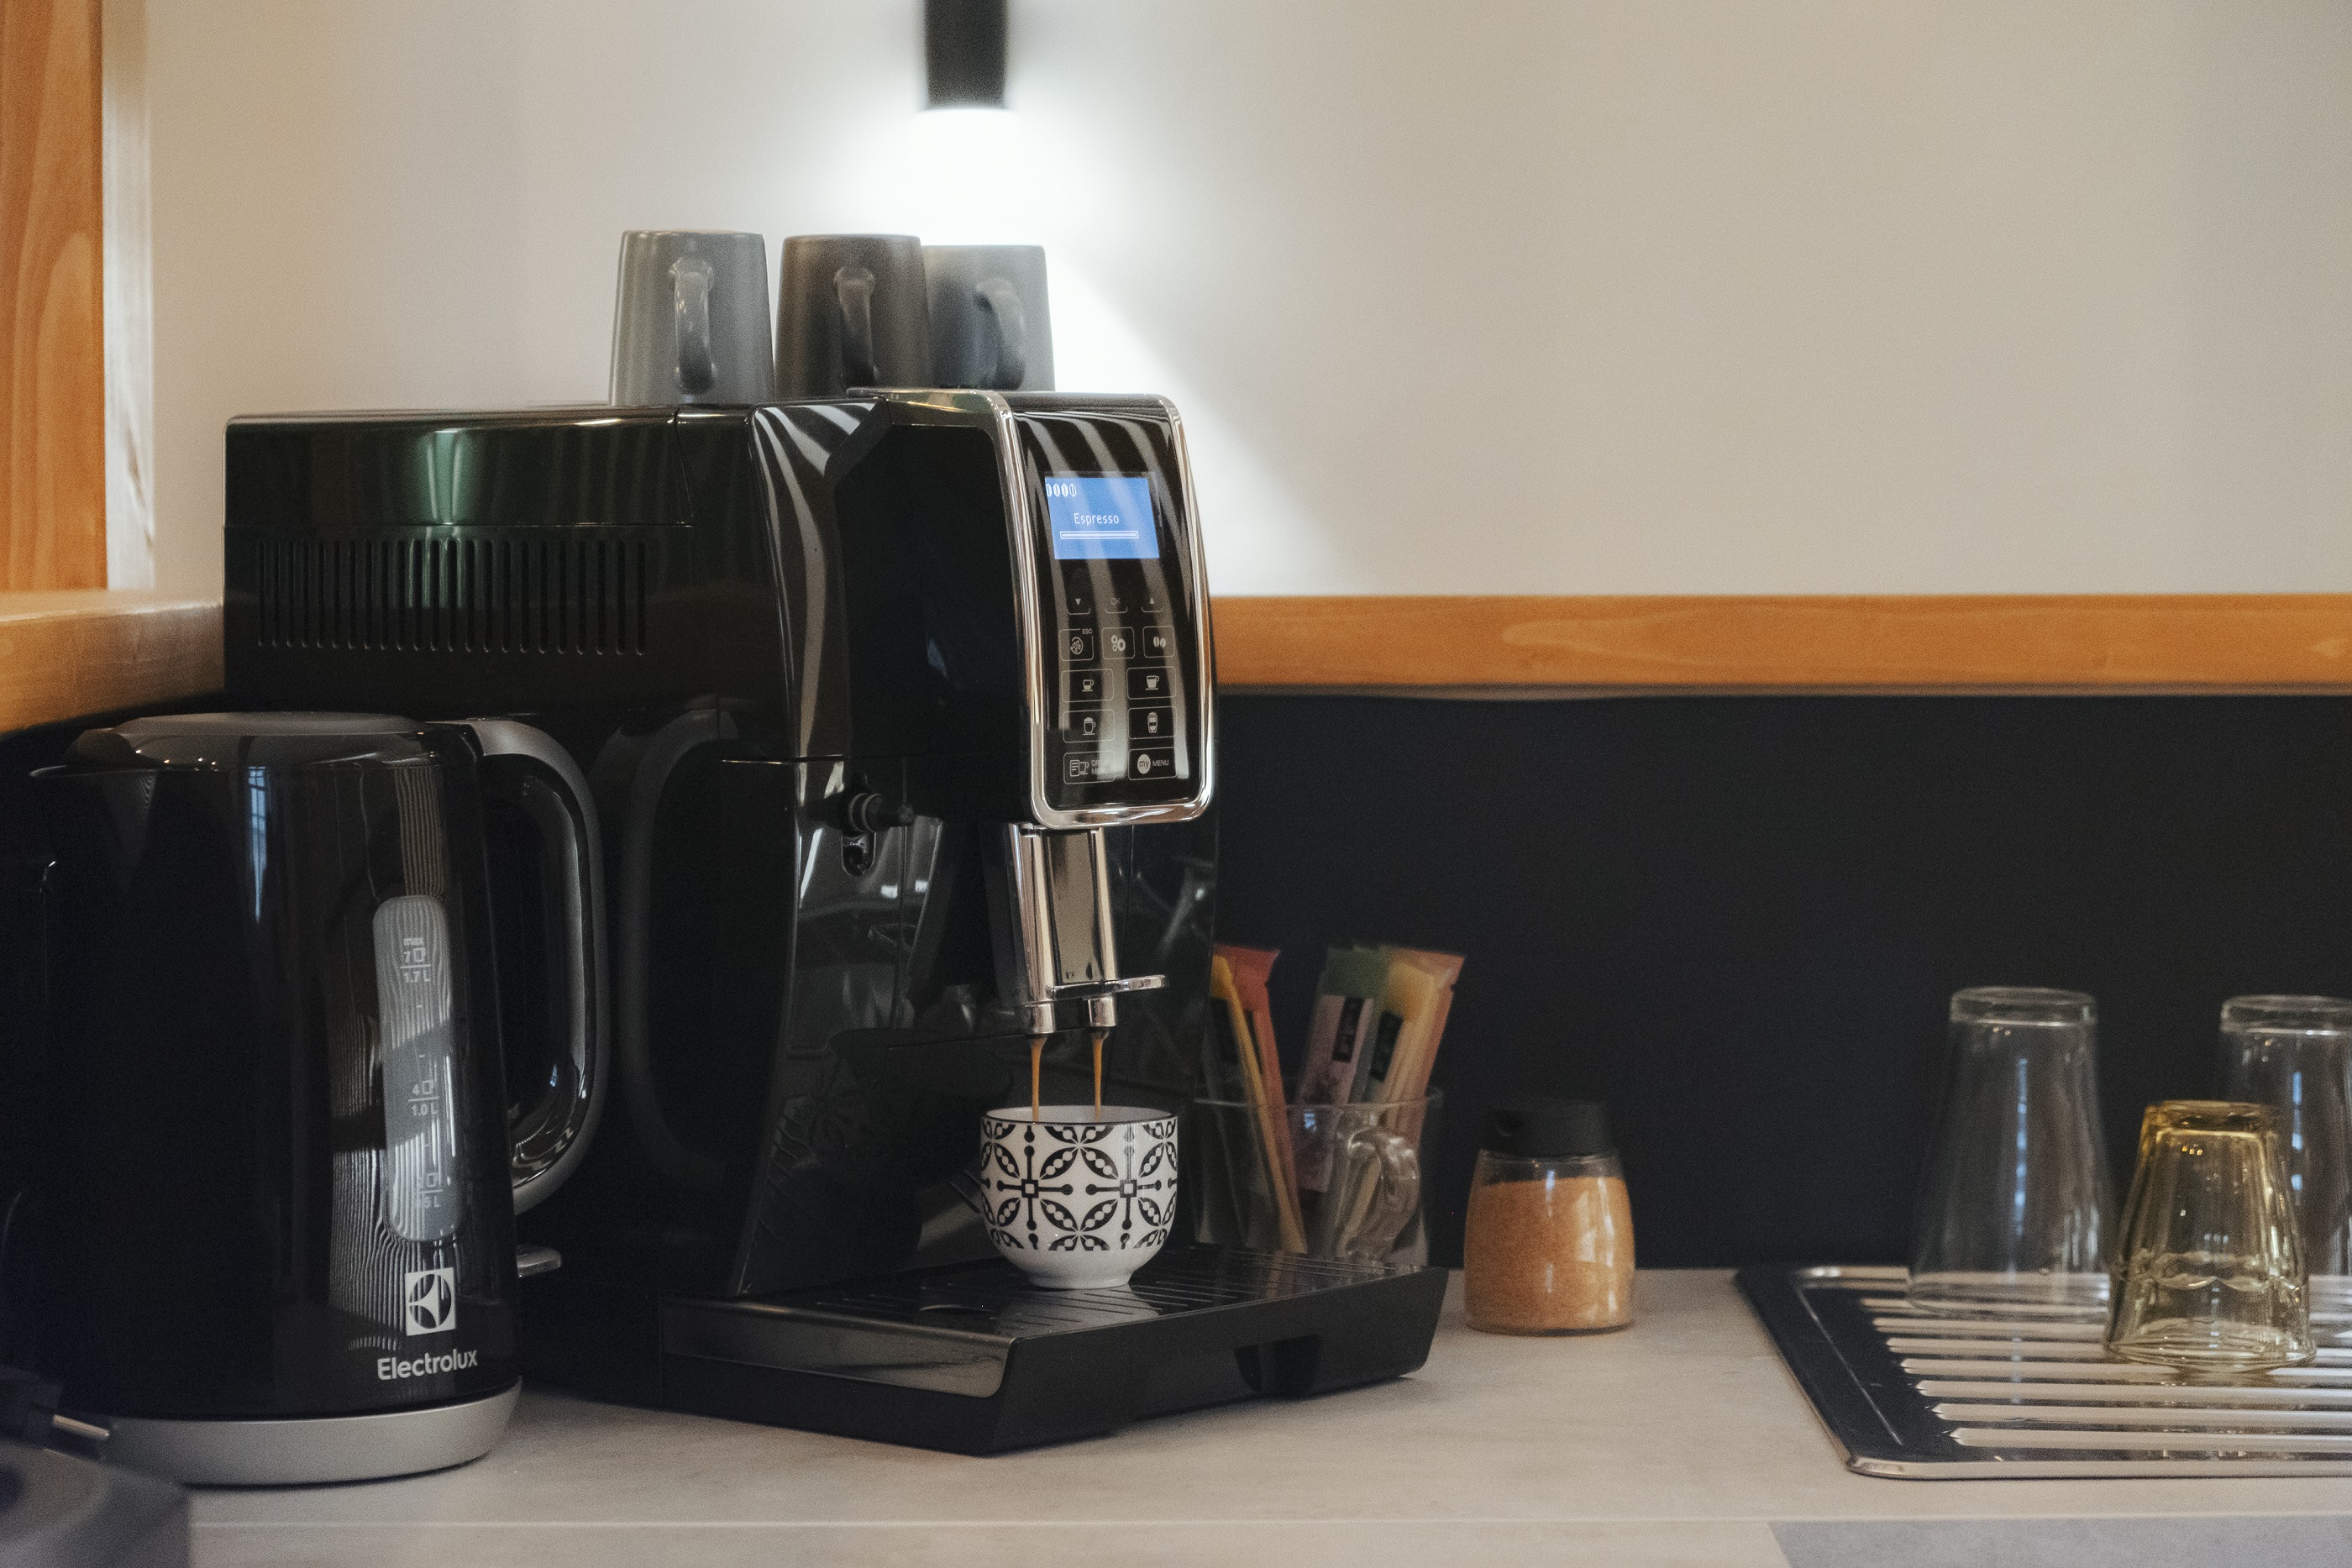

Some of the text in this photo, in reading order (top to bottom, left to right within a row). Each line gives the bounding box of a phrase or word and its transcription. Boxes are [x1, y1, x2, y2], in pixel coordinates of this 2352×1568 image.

[1074, 512, 1120, 526] Espresso
[403, 951, 411, 963] 7
[403, 970, 430, 983] 1.7 L
[412, 1083, 420, 1096] 4
[412, 1102, 438, 1116] 1.0 L
[377, 1348, 478, 1380] Electrolux
